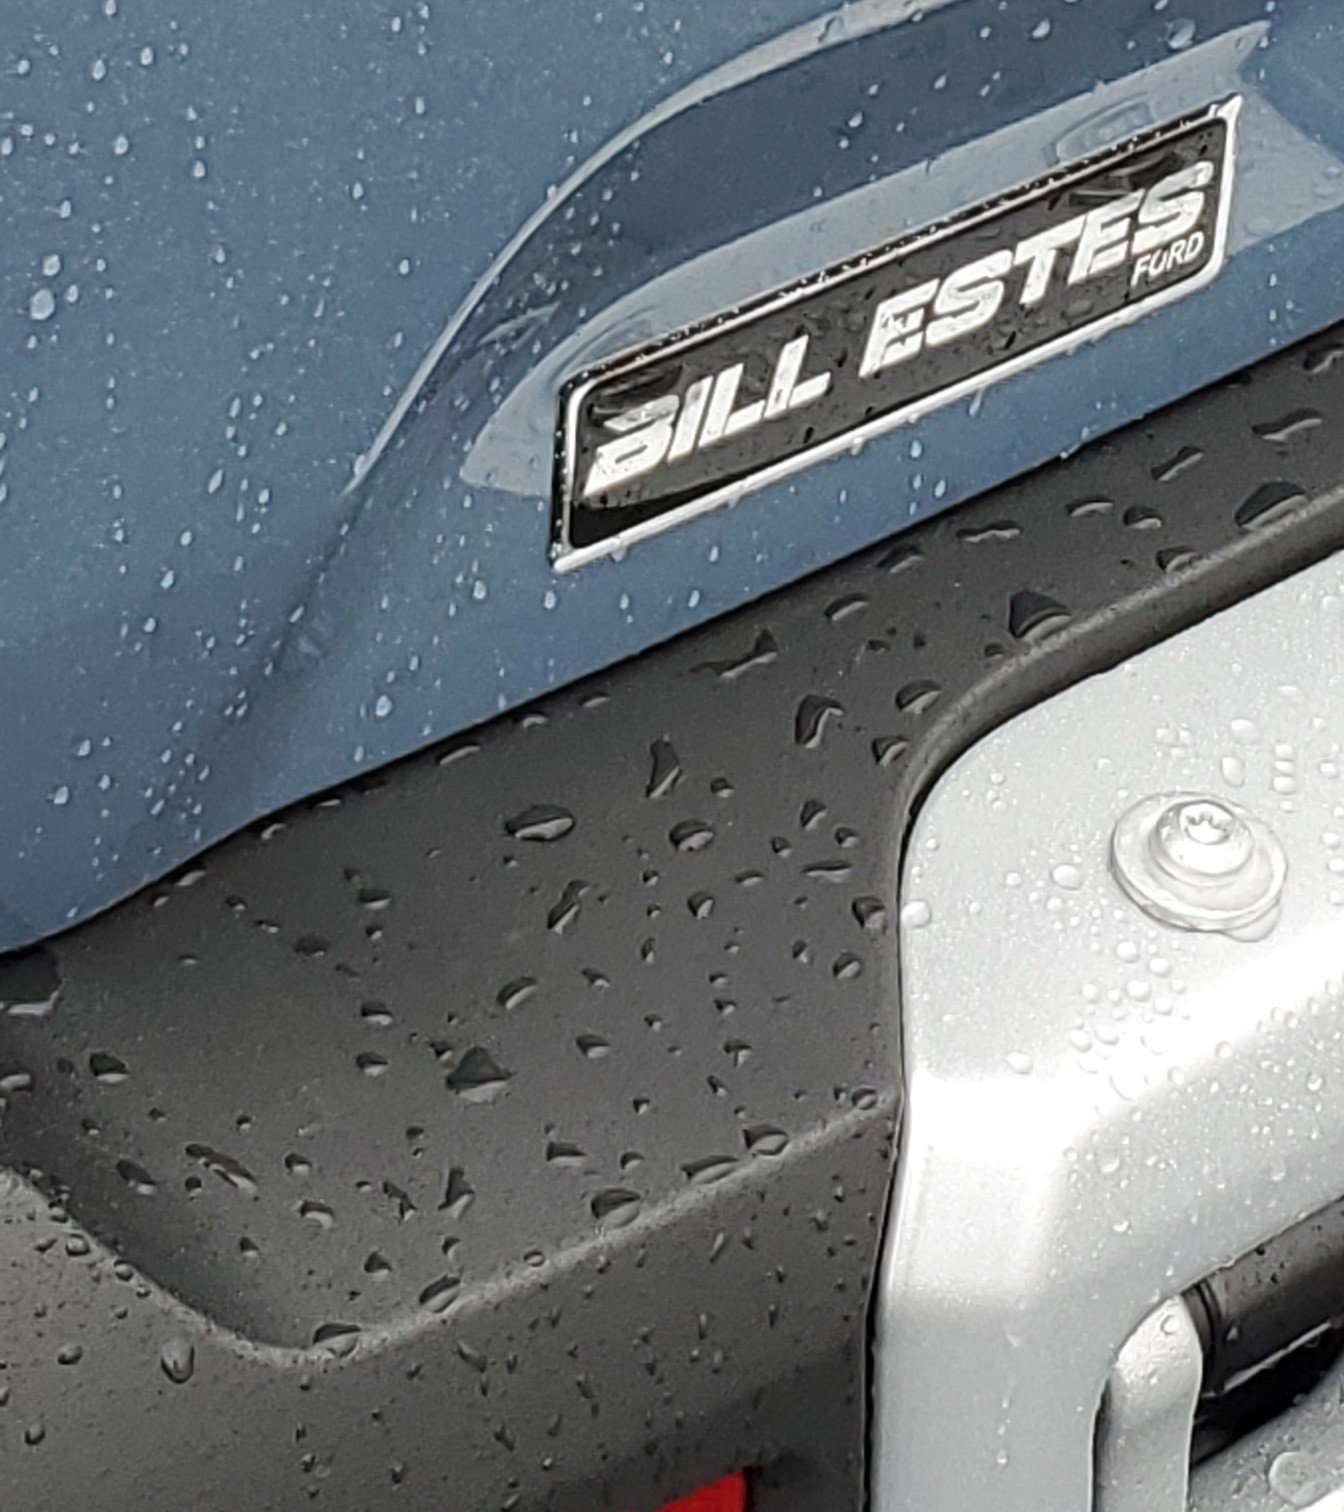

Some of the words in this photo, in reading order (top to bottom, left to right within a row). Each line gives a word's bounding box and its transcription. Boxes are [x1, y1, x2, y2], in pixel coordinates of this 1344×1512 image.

[582, 334, 832, 498] BILL
[858, 160, 1214, 380] ESTES
[1130, 230, 1206, 288] FORD
